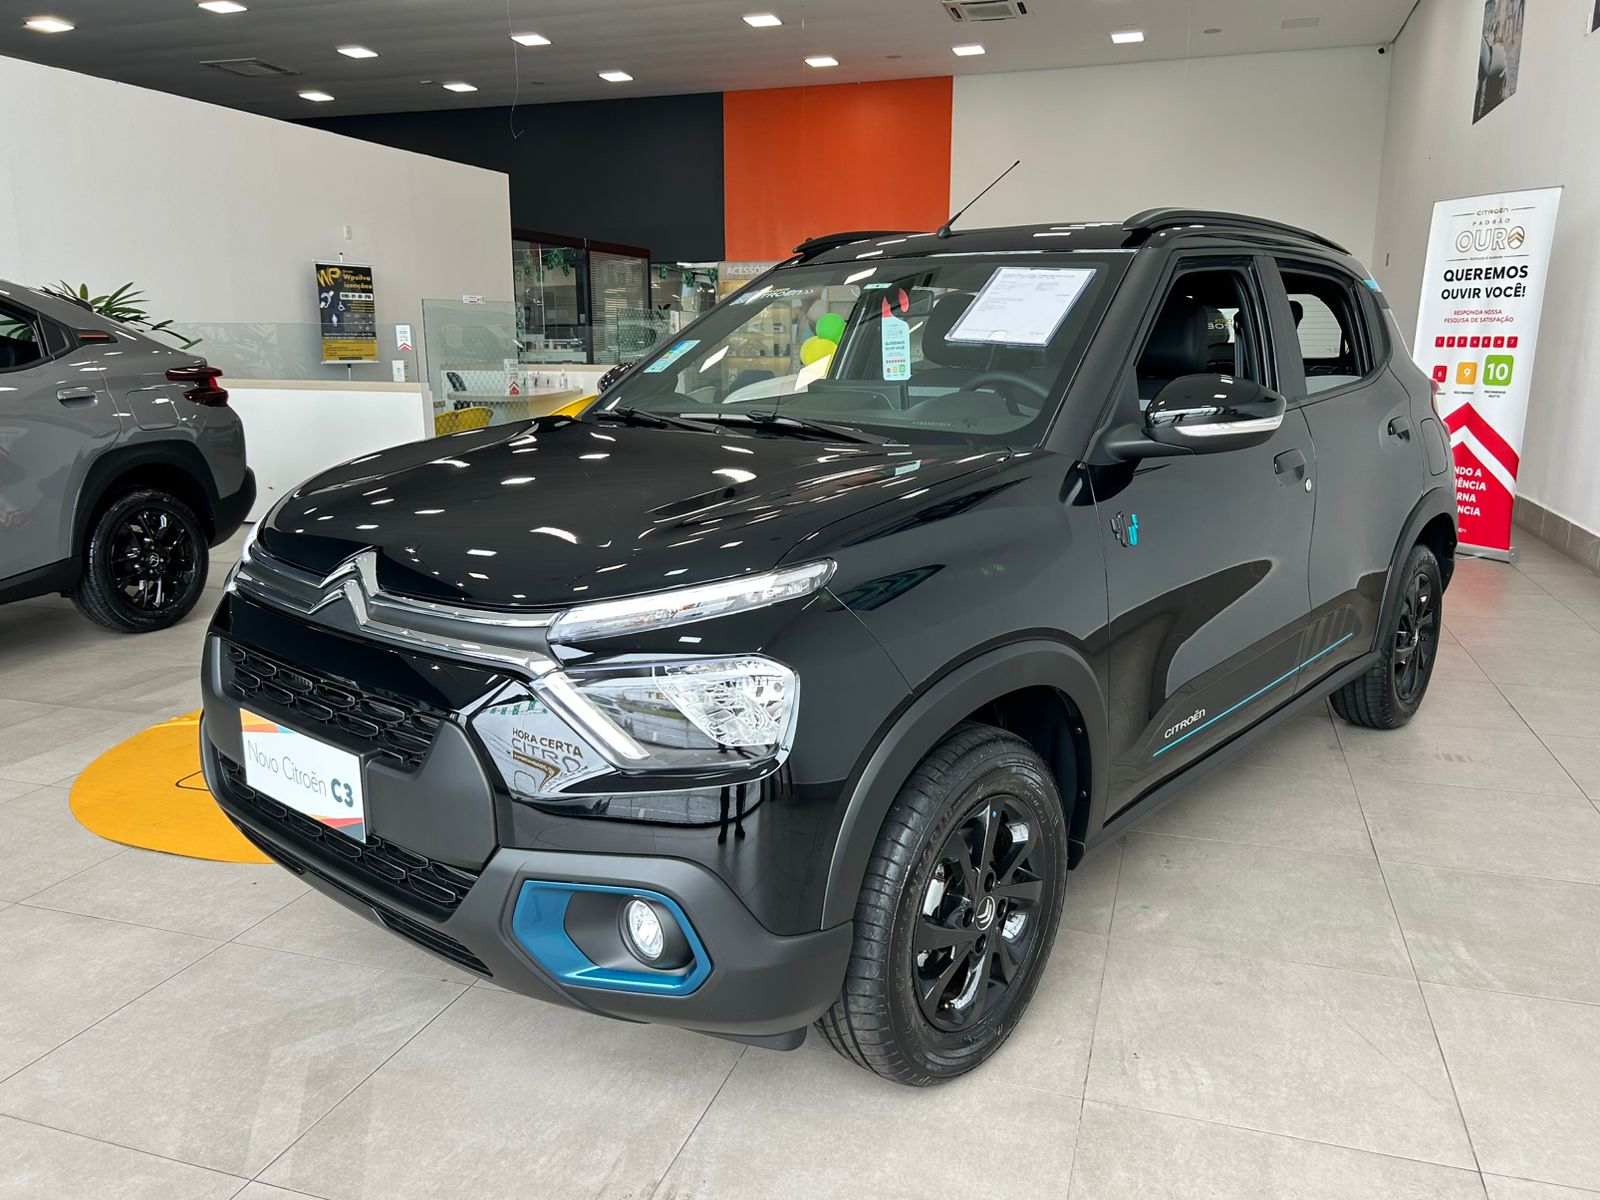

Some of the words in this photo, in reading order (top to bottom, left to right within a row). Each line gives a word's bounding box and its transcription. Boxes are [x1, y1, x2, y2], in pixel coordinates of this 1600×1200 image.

[1455, 225, 1526, 253] OURO
[1443, 265, 1529, 282] QUEREMOS
[1441, 287, 1482, 300] OUVIR
[1485, 282, 1527, 299] VOCÊ!
[1479, 315, 1514, 324] SATISFAÇÃO
[1463, 367, 1471, 378] 9
[1487, 363, 1509, 381] 10
[1454, 466, 1473, 476] NDO
[1474, 468, 1482, 477] A
[1455, 476, 1487, 491] IÊNCIA
[1456, 491, 1476, 503] RNA
[1457, 504, 1480, 517] NCIA
[512, 727, 538, 744] HORA
[540, 737, 584, 759] CERTA
[247, 739, 279, 774] Novo
[282, 756, 327, 797] Citroën
[330, 778, 354, 809] C3
